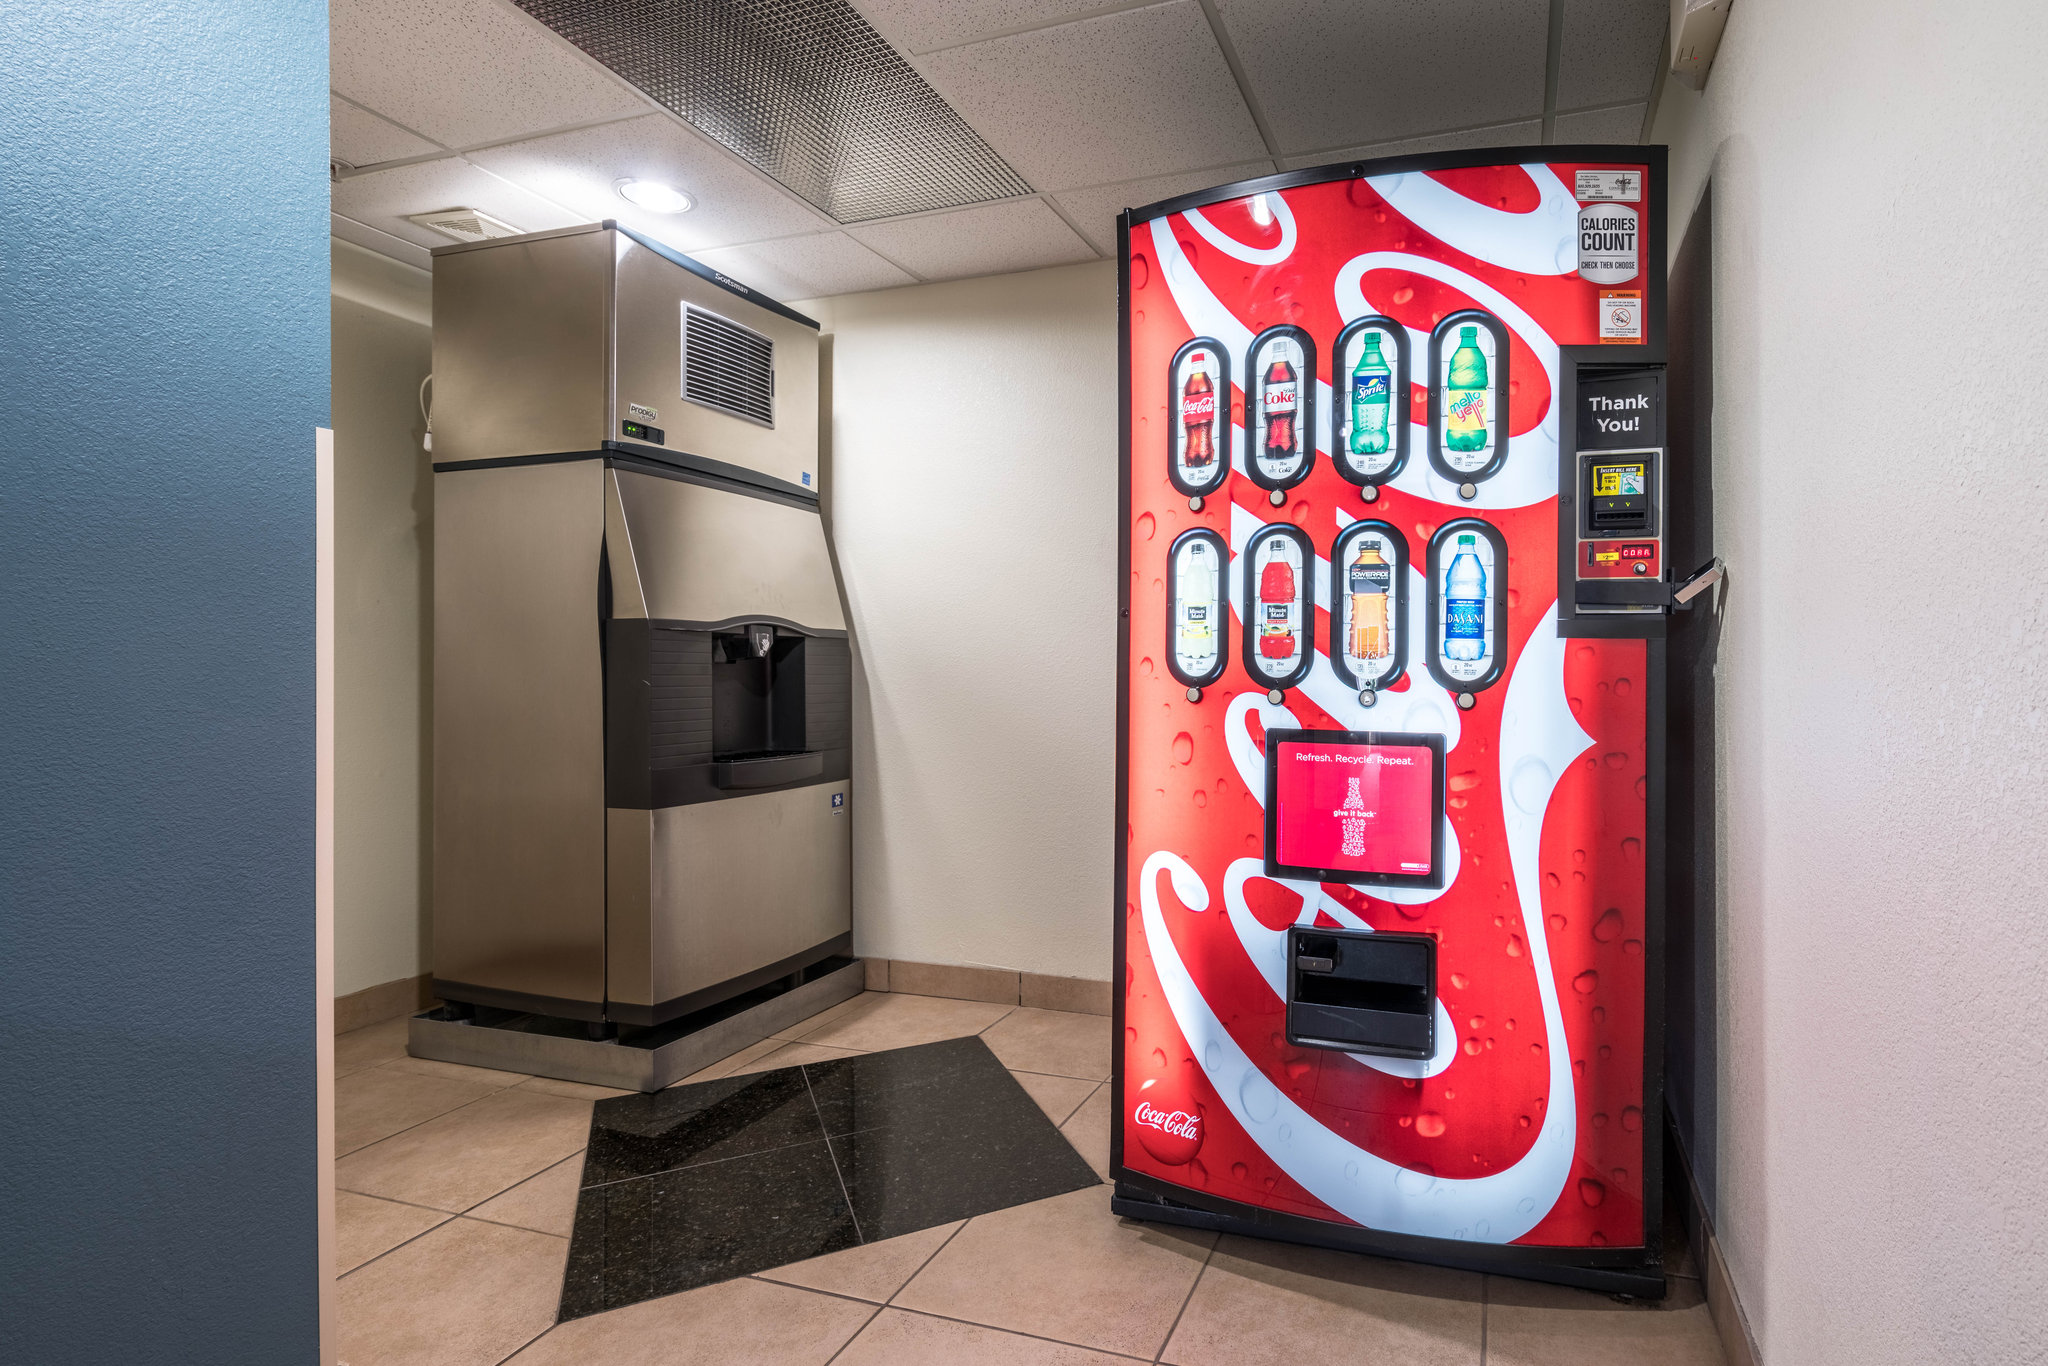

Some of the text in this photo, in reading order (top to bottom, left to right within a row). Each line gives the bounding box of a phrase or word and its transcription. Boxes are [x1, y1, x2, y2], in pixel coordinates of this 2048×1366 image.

[1582, 218, 1635, 231] CALORIES
[1581, 260, 1635, 270] CHECK THEN CHOOSE
[715, 272, 748, 294] Scotsman
[1264, 392, 1295, 405] Coke
[1357, 383, 1385, 400] Sprite
[1183, 396, 1214, 415] Coca-Cola
[1450, 392, 1481, 414] mello
[1589, 394, 1649, 412] Thank
[1456, 399, 1484, 428] yello
[1597, 416, 1640, 432] You!
[1448, 611, 1483, 625] DASANI
[1296, 753, 1414, 766] Refresh. Recycle. Repeat.
[1134, 1102, 1202, 1140] Coca-Cola
